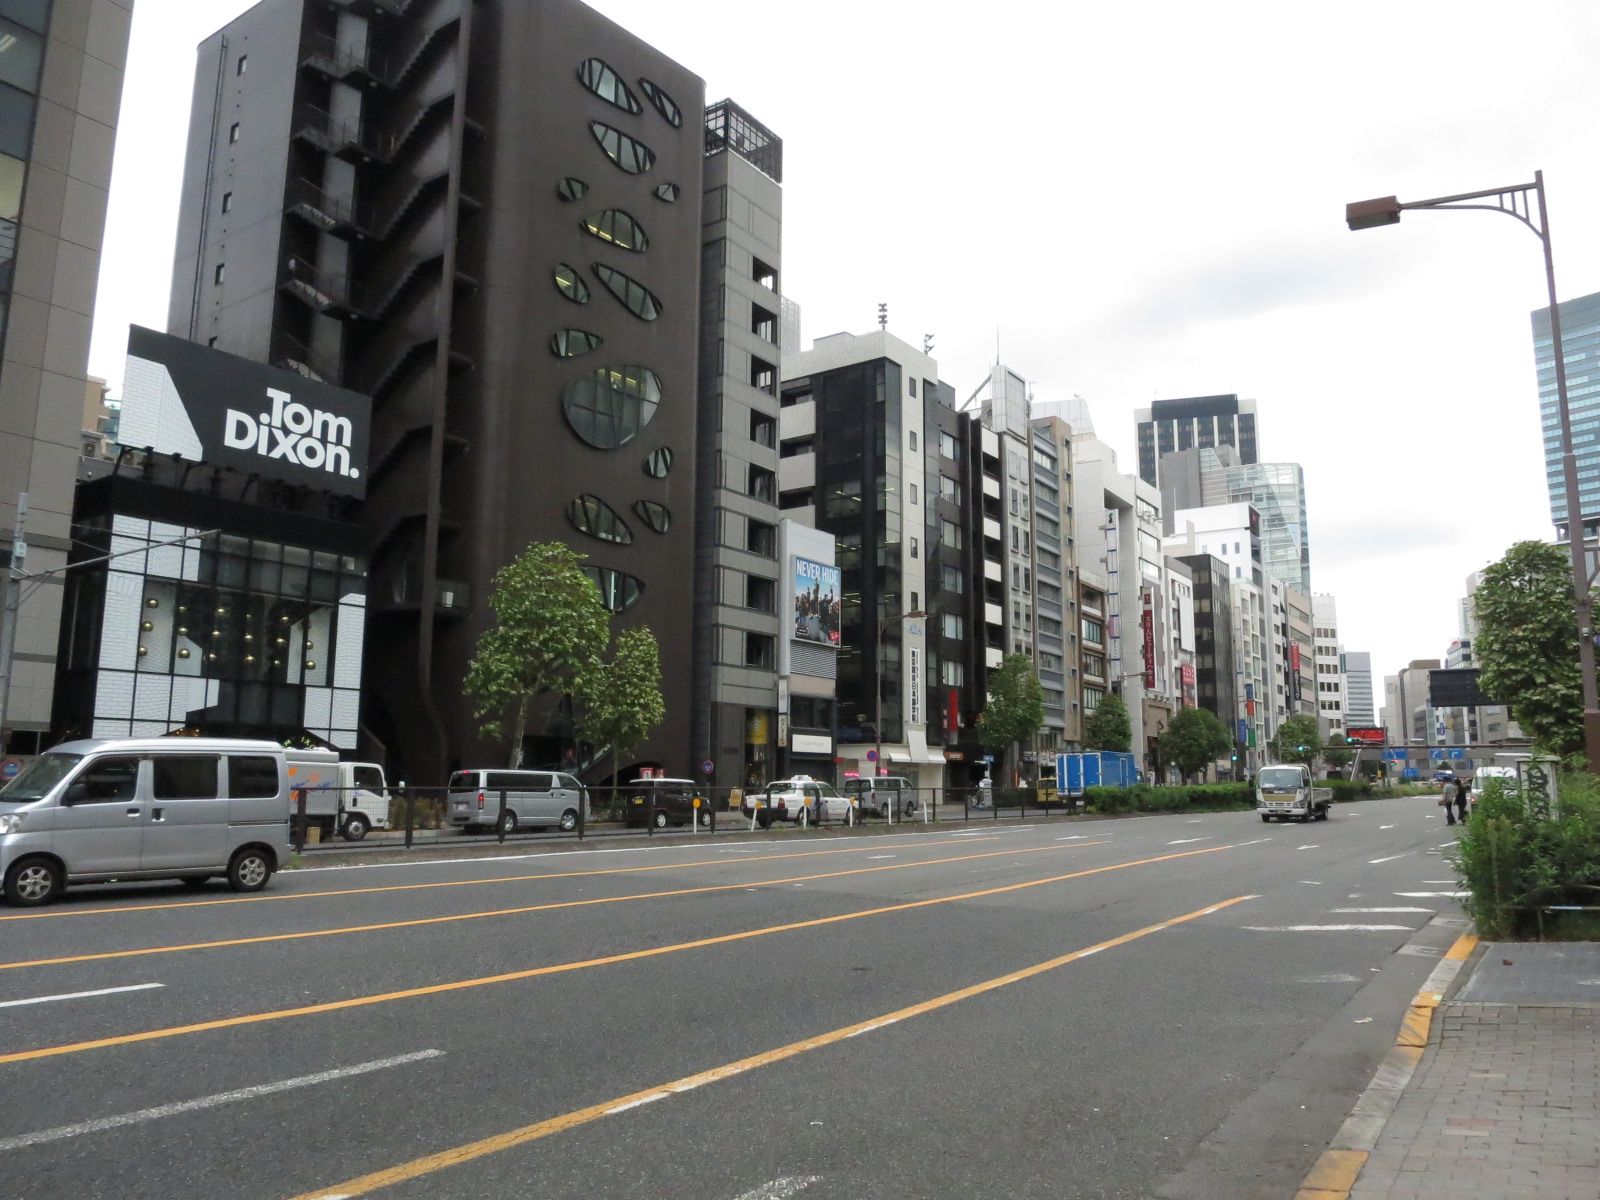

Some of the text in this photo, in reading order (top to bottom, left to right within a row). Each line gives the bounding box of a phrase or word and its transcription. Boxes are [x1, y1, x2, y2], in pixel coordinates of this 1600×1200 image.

[225, 408, 360, 479] Dixon.
[266, 387, 352, 447] Tom
[796, 559, 840, 586] NEVER HIDE
